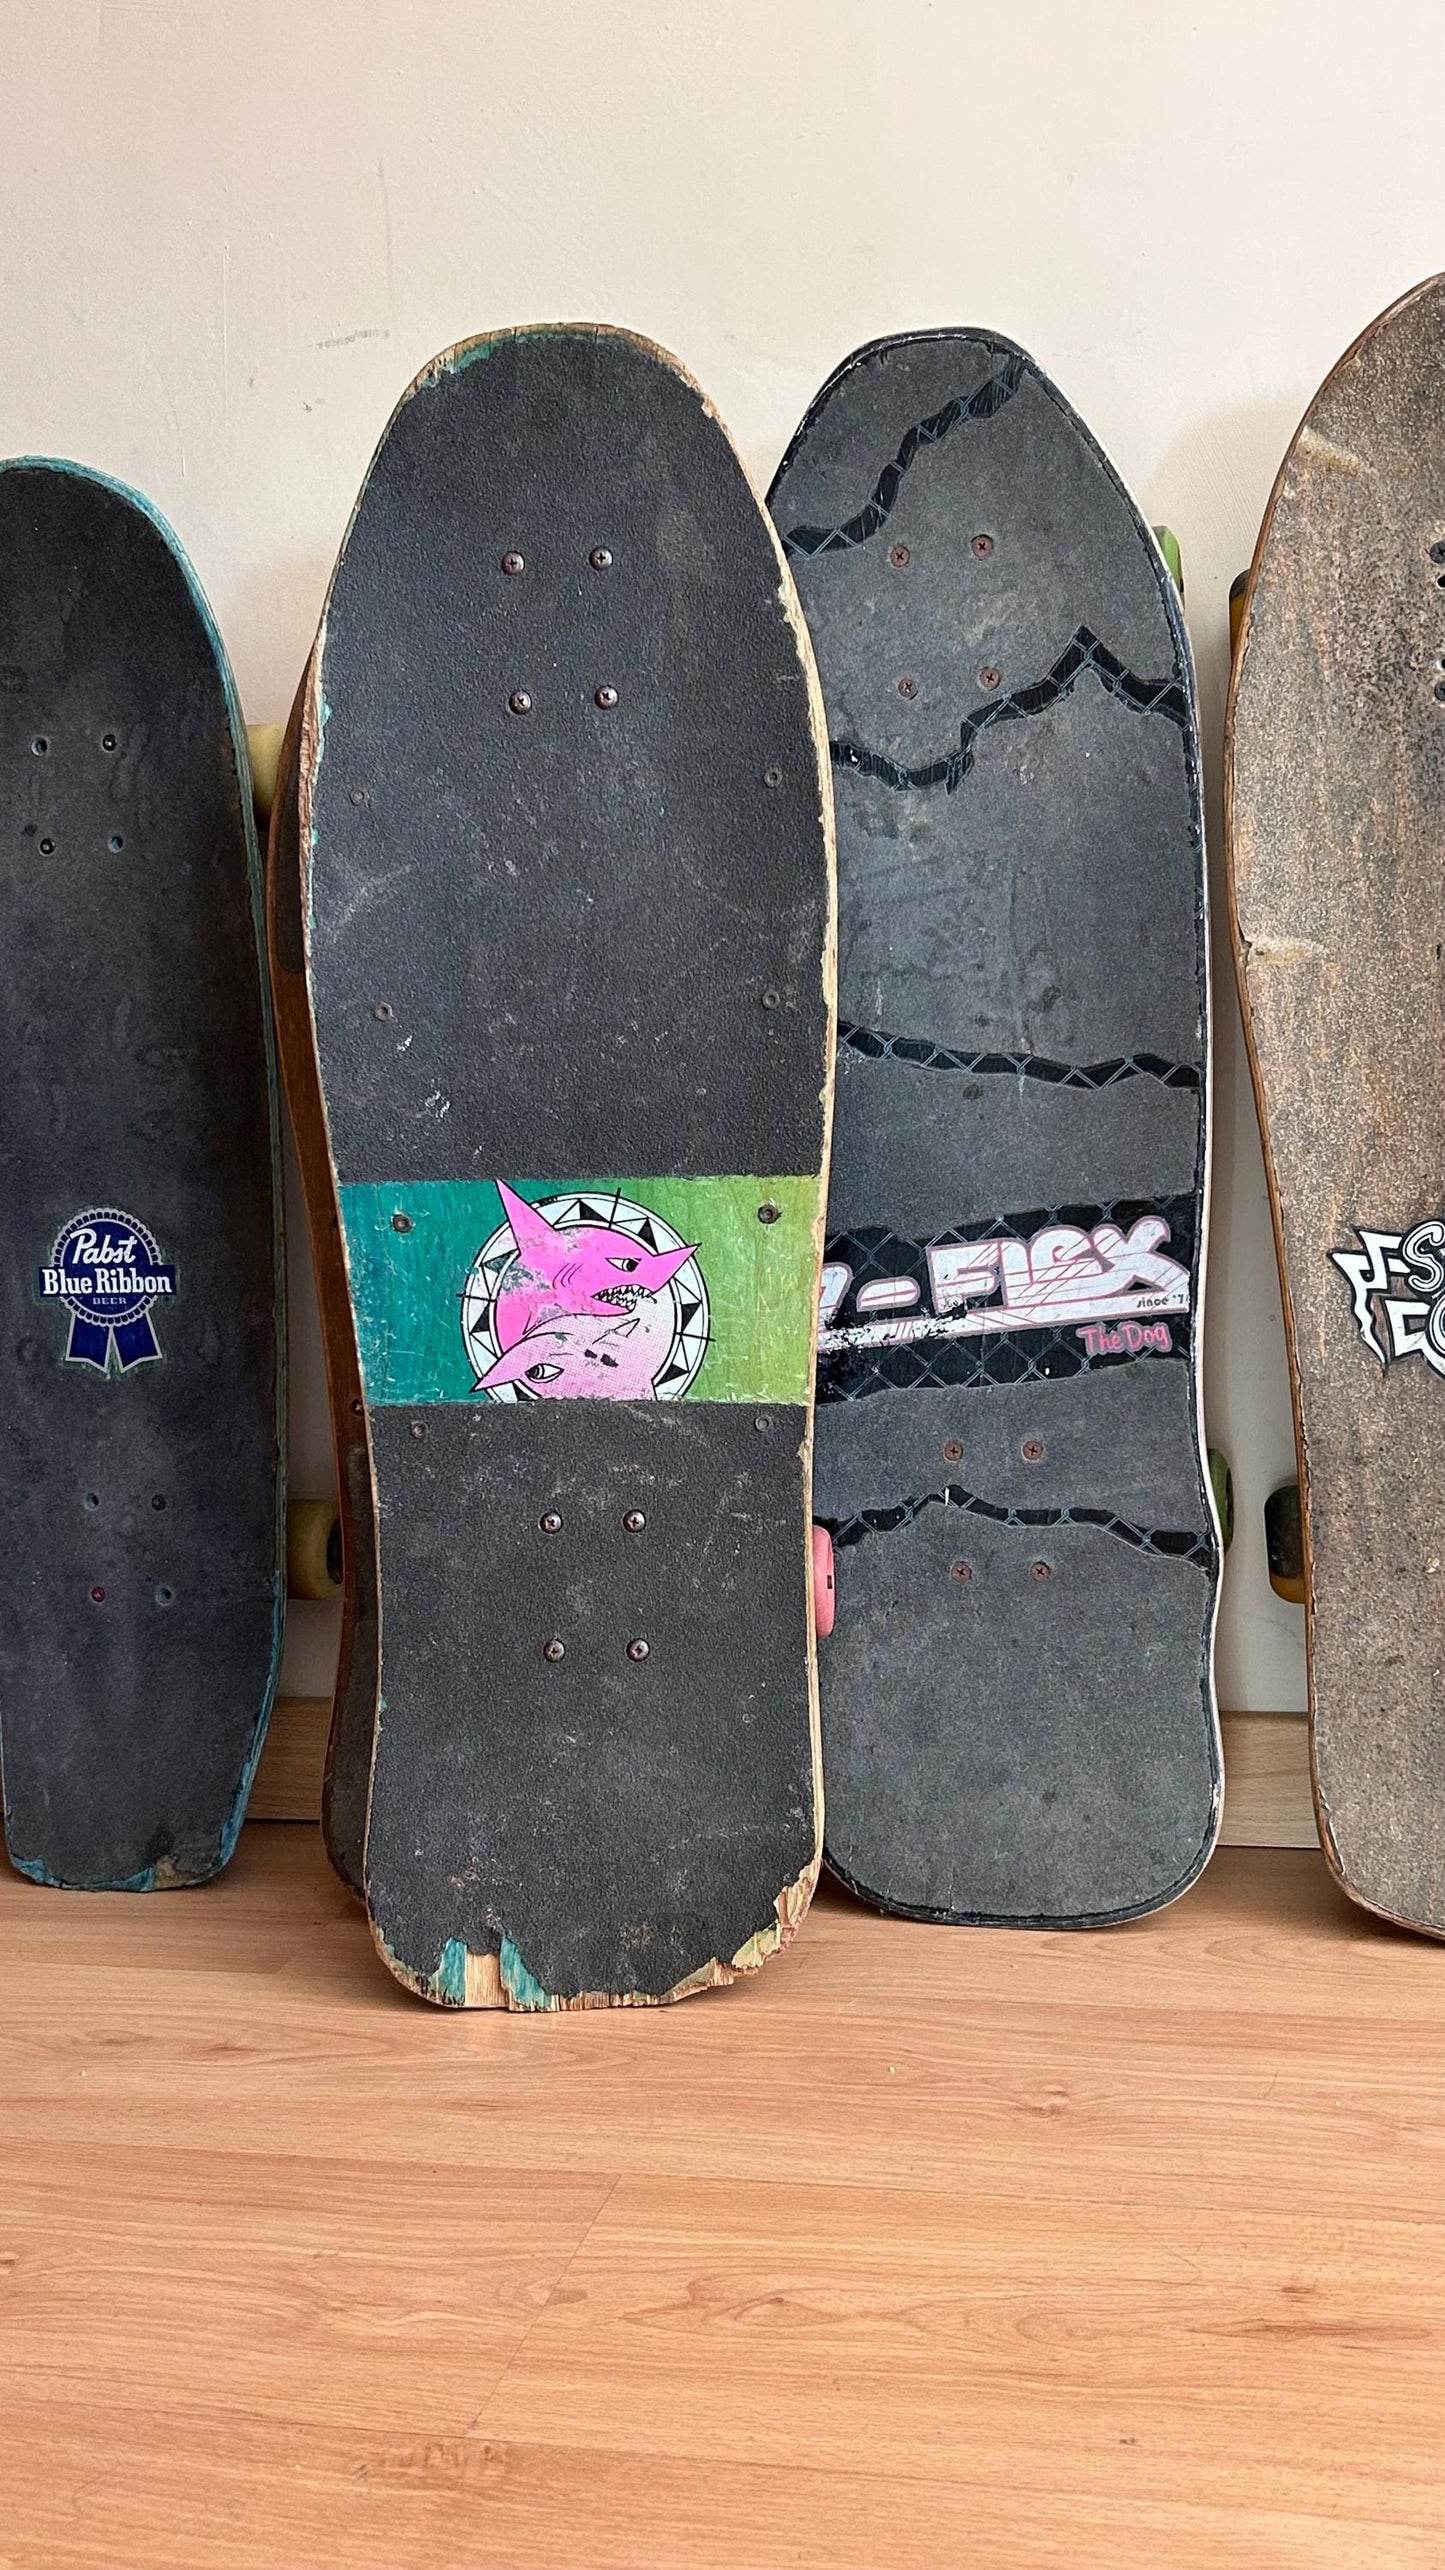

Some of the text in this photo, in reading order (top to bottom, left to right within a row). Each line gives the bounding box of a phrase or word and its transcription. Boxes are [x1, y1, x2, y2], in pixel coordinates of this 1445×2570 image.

[69, 1228, 138, 1264] Pabst
[42, 1267, 173, 1295] Blue Ribbon
[92, 1297, 128, 1305] BEER
[1136, 1296, 1169, 1309] since
[1078, 1322, 1171, 1353] The Dog
